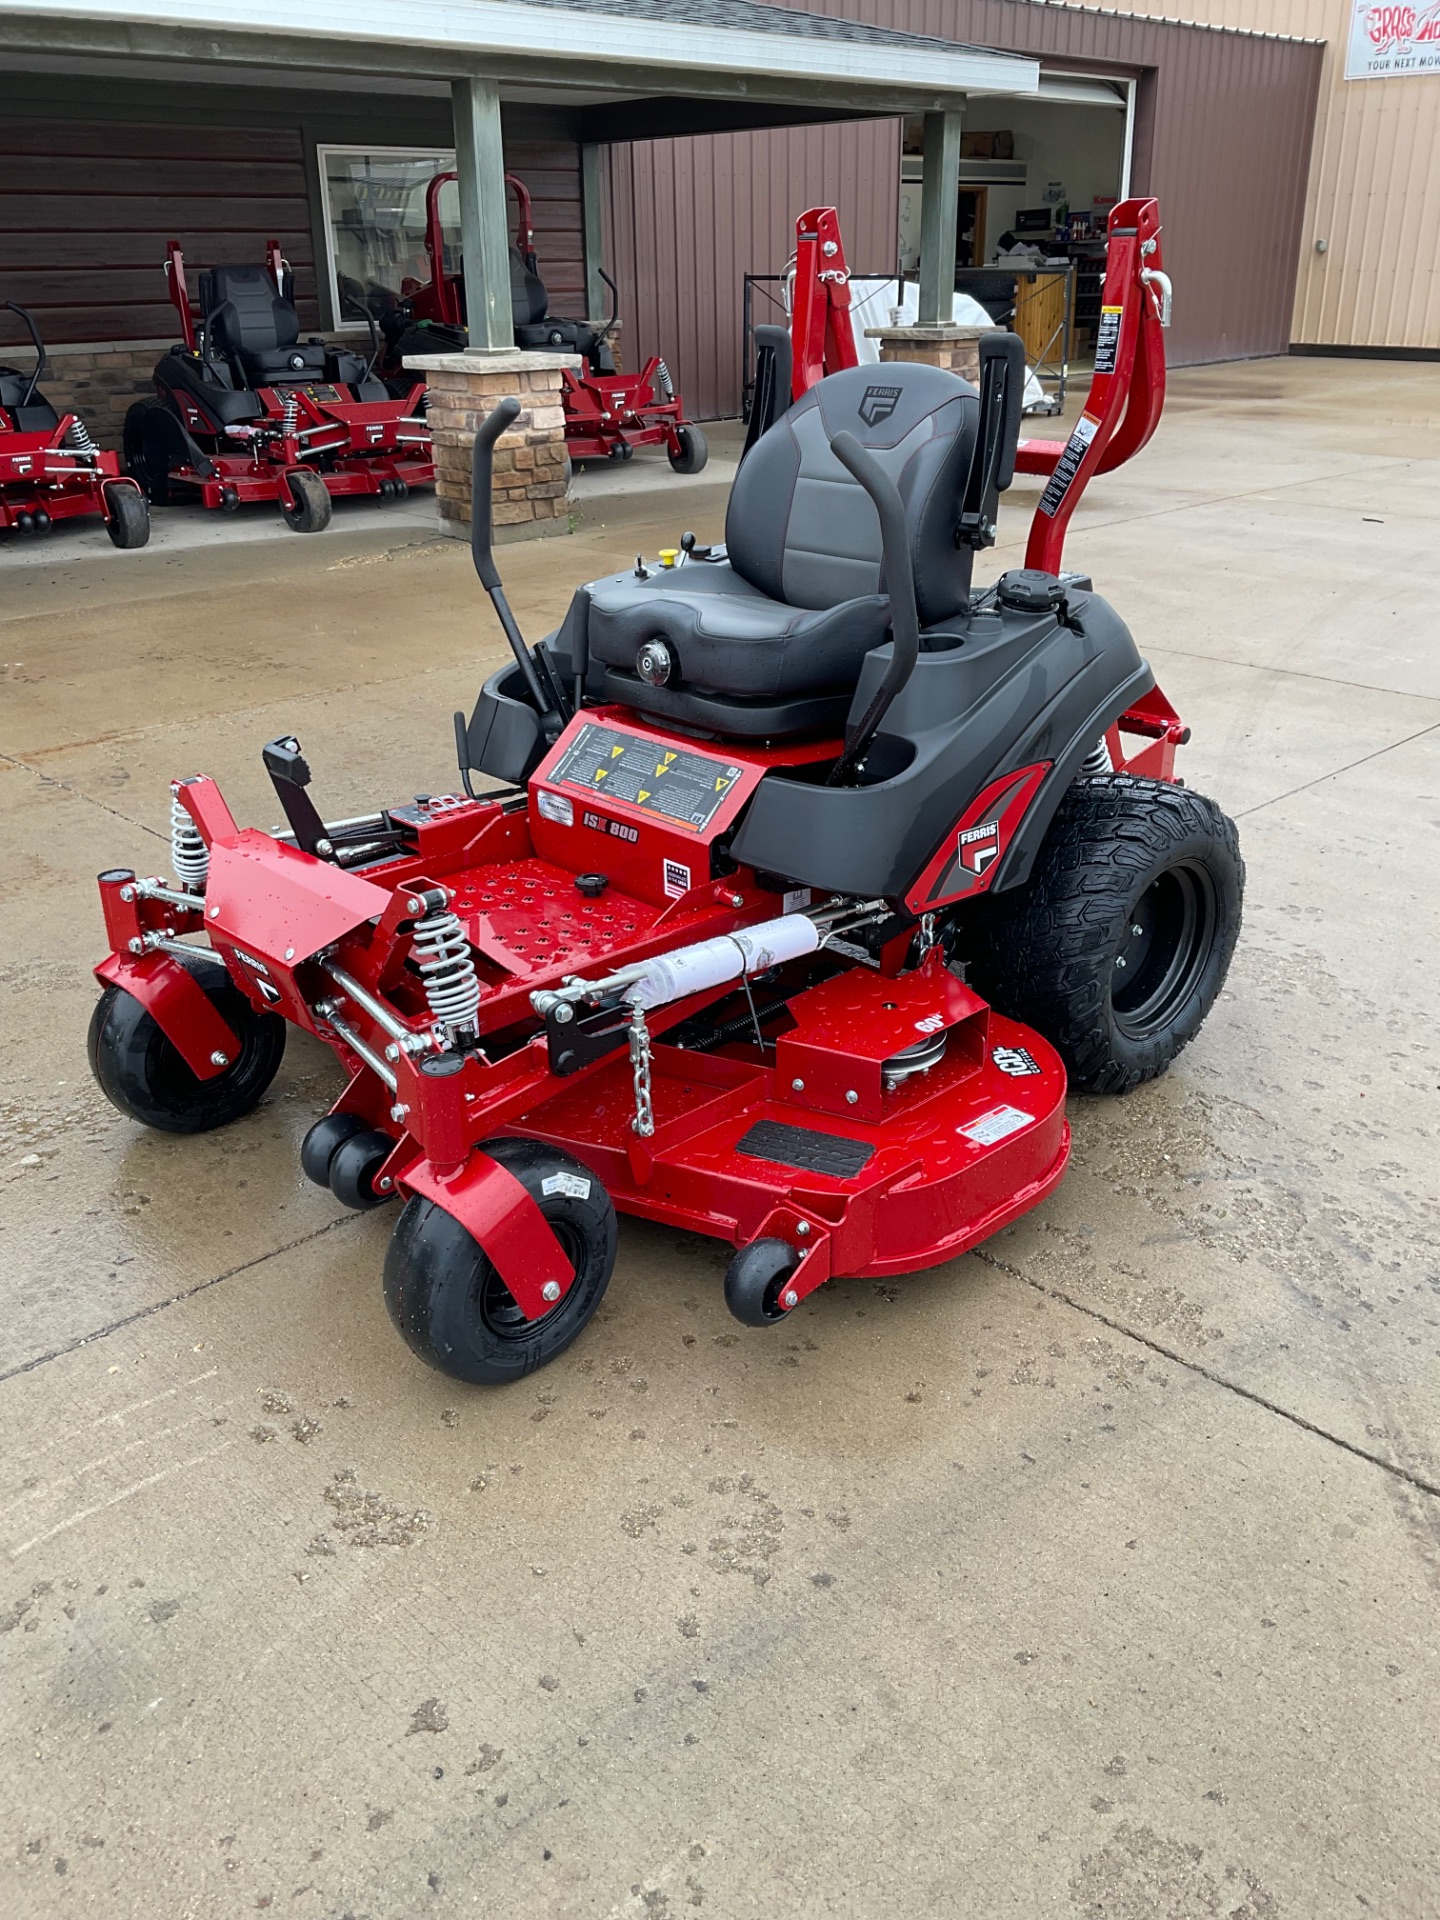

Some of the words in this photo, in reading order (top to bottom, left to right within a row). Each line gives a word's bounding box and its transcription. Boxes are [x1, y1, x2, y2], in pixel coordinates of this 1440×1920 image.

[1368, 60, 1391, 71] YOUR
[1394, 57, 1416, 69] NEXT
[867, 387, 900, 397] FERRIS
[583, 812, 607, 832] ISX
[610, 822, 638, 842] 800
[961, 823, 997, 845] FERRIS
[234, 948, 269, 975] FERRIS
